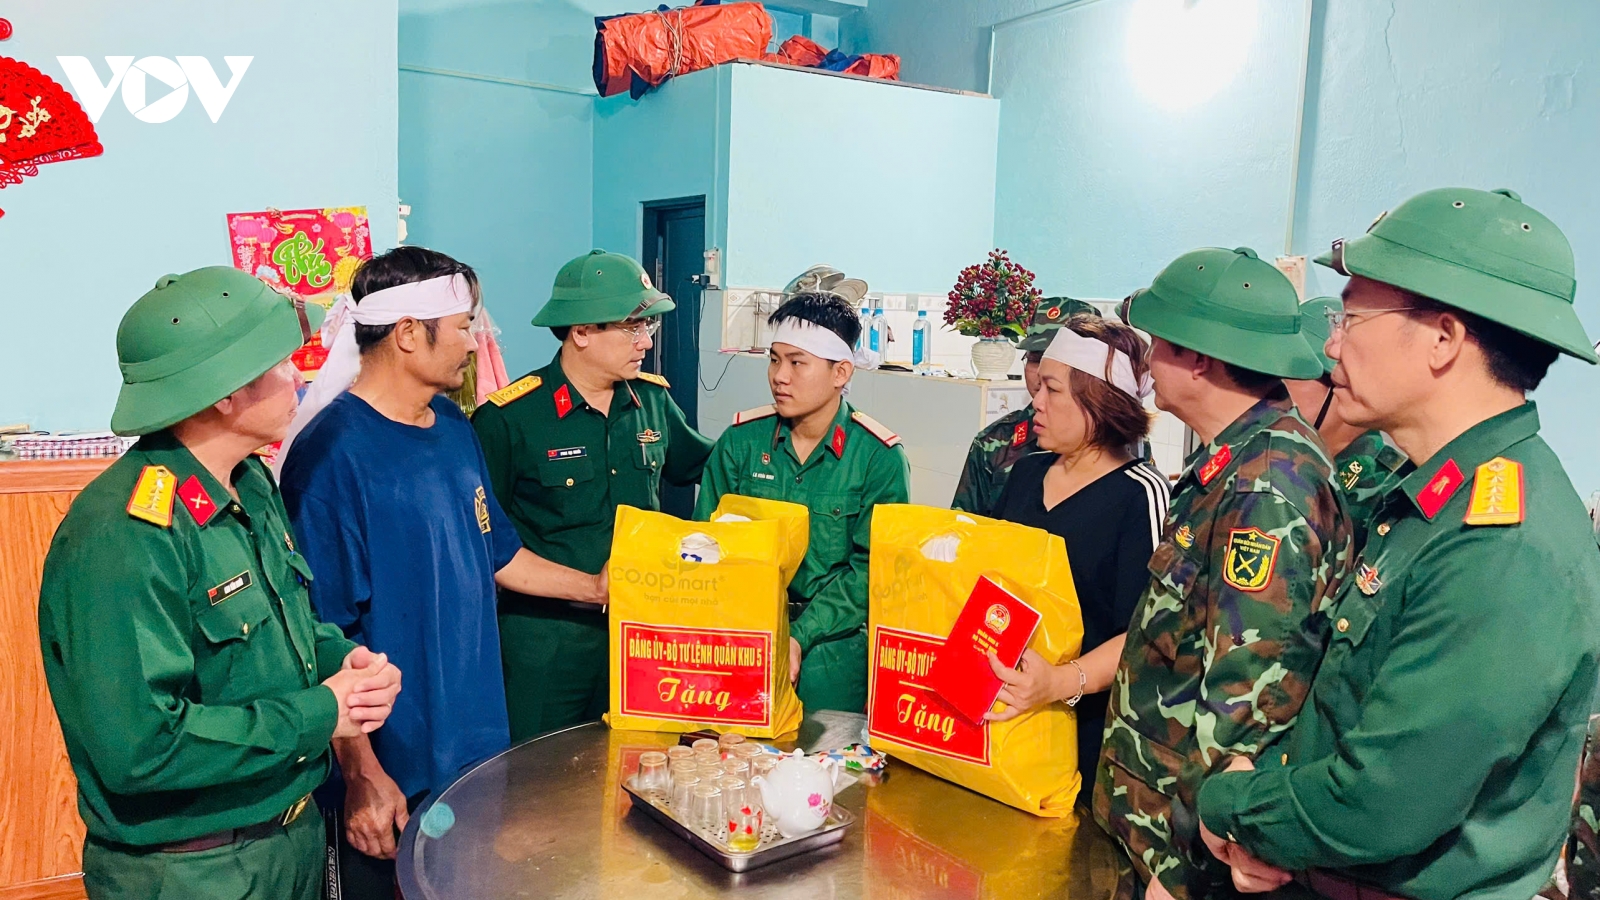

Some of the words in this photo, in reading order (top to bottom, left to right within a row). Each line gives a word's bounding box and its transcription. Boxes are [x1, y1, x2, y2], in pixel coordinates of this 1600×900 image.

[629, 633, 651, 659] ĐẢNG
[680, 642, 691, 663] TƯ
[691, 640, 712, 668] LỆNH
[713, 642, 736, 667] QUÂN
[738, 647, 755, 667] KHU
[756, 648, 762, 667] 5
[879, 639, 896, 671] ĐẢNG
[657, 677, 732, 712] Tặng
[897, 693, 956, 742] Tặng
